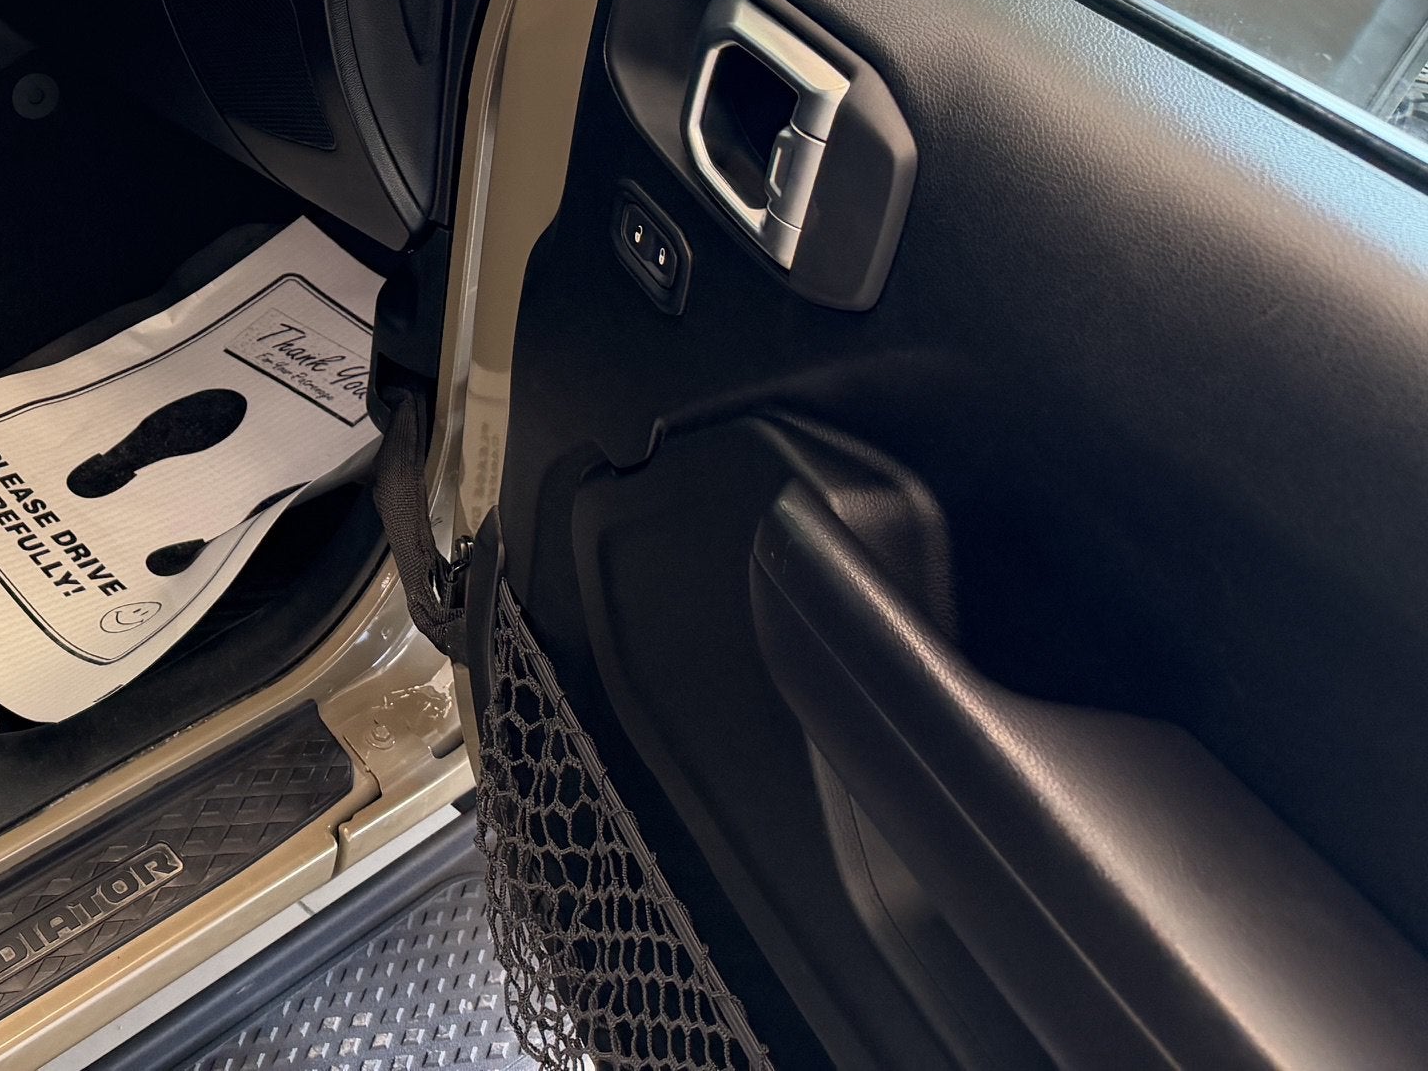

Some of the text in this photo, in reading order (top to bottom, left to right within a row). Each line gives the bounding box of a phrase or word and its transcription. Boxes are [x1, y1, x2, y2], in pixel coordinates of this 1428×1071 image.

[257, 323, 369, 400] Thank You
[50, 529, 128, 597] DRIVE
